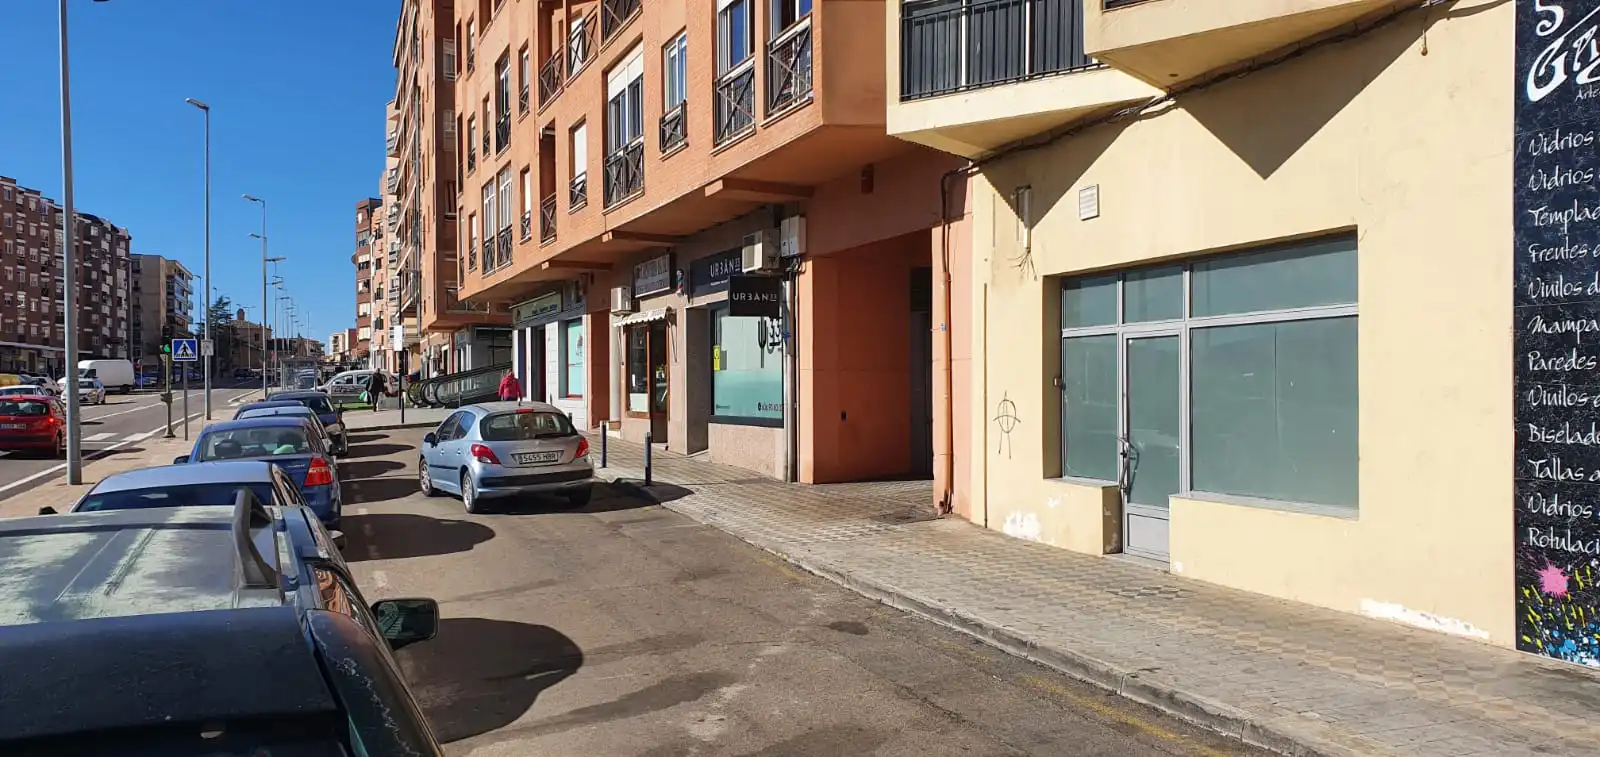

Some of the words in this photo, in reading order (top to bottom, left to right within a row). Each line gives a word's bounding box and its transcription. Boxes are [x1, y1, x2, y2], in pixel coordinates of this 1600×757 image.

[1529, 128, 1594, 156] Vidrios
[1528, 165, 1594, 192] Vidrios
[1528, 236, 1588, 263] Frentes
[1528, 274, 1582, 298] Vinilos
[1527, 315, 1600, 344] Mampa
[1528, 347, 1597, 371] Paredes
[1528, 384, 1588, 407] Vinilos
[1528, 457, 1584, 481] Tallas
[1528, 493, 1593, 519] Vidrios
[1528, 526, 1600, 554] Rotulaci
